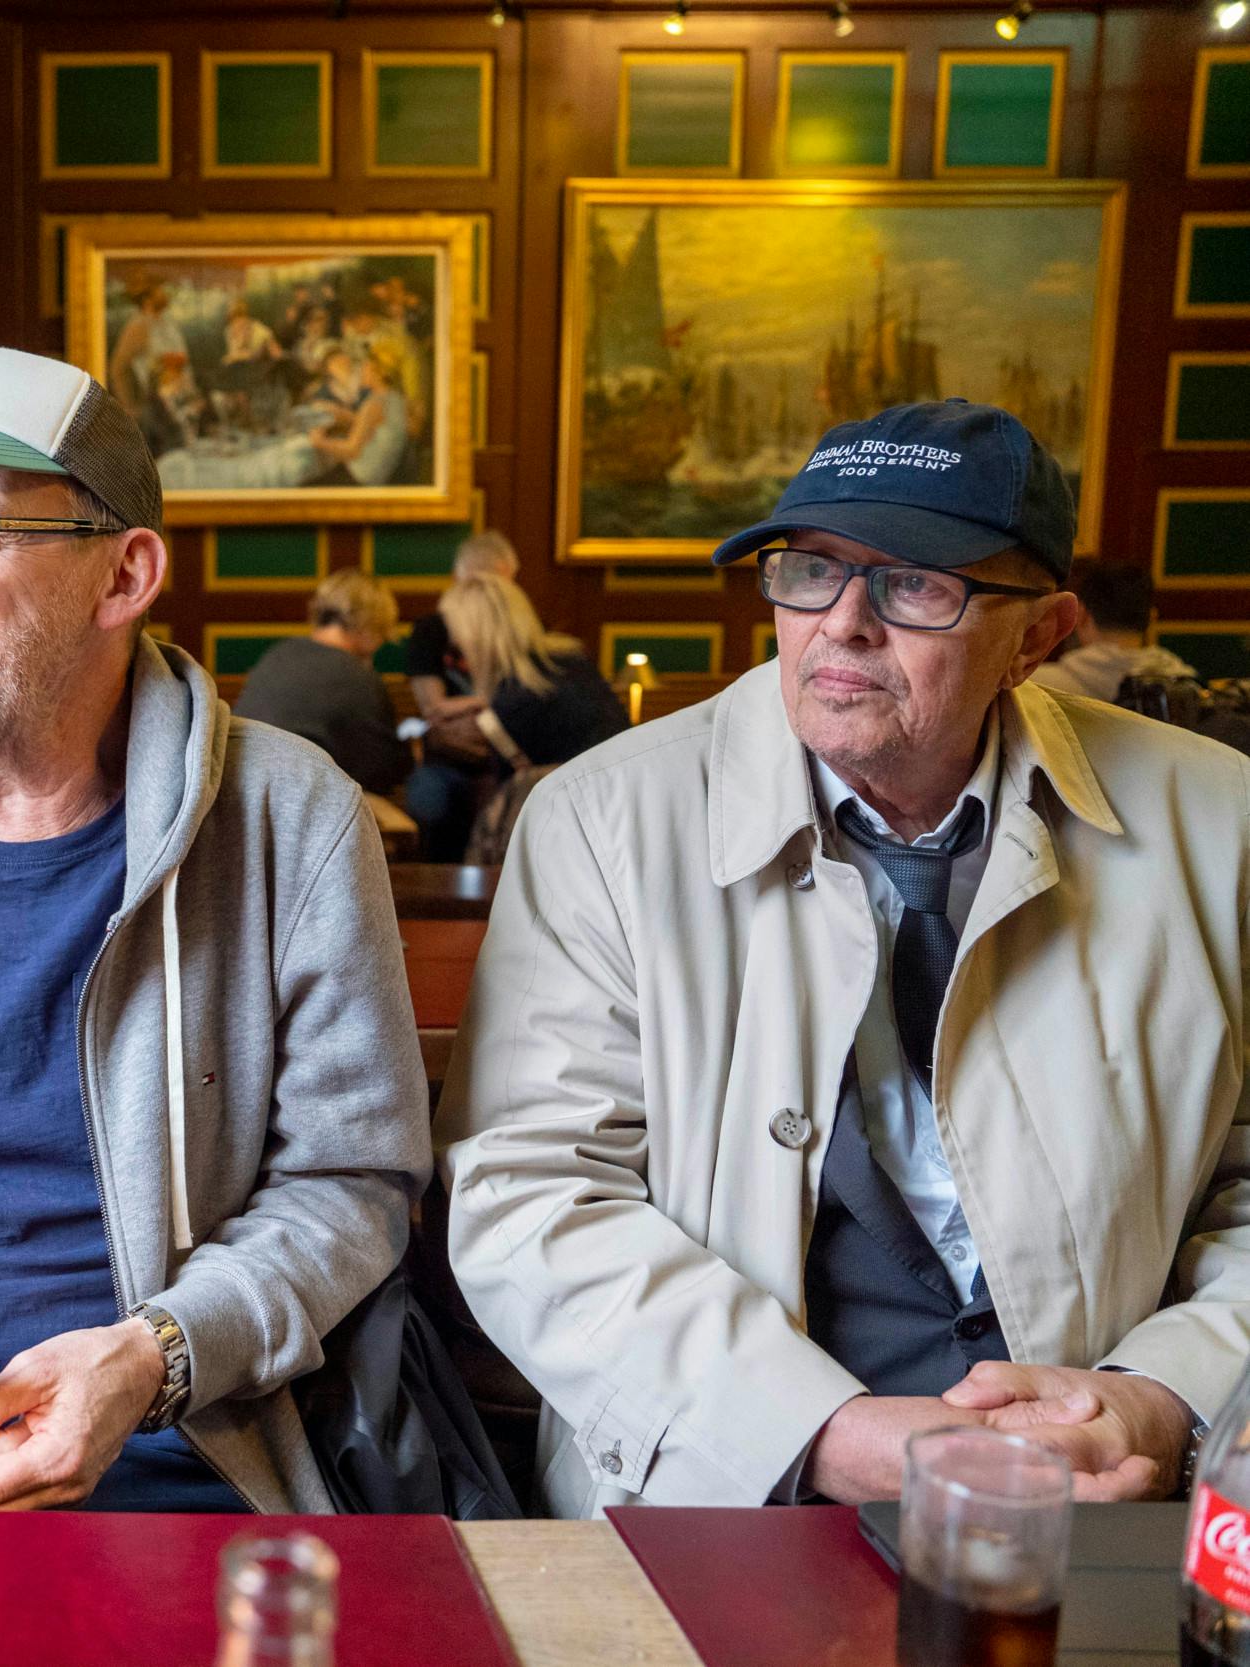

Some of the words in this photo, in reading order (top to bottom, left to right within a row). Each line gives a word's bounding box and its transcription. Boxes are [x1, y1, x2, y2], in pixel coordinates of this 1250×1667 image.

[858, 440, 963, 464] BROTHERS
[805, 459, 832, 473] RISK
[837, 467, 878, 477] 2008
